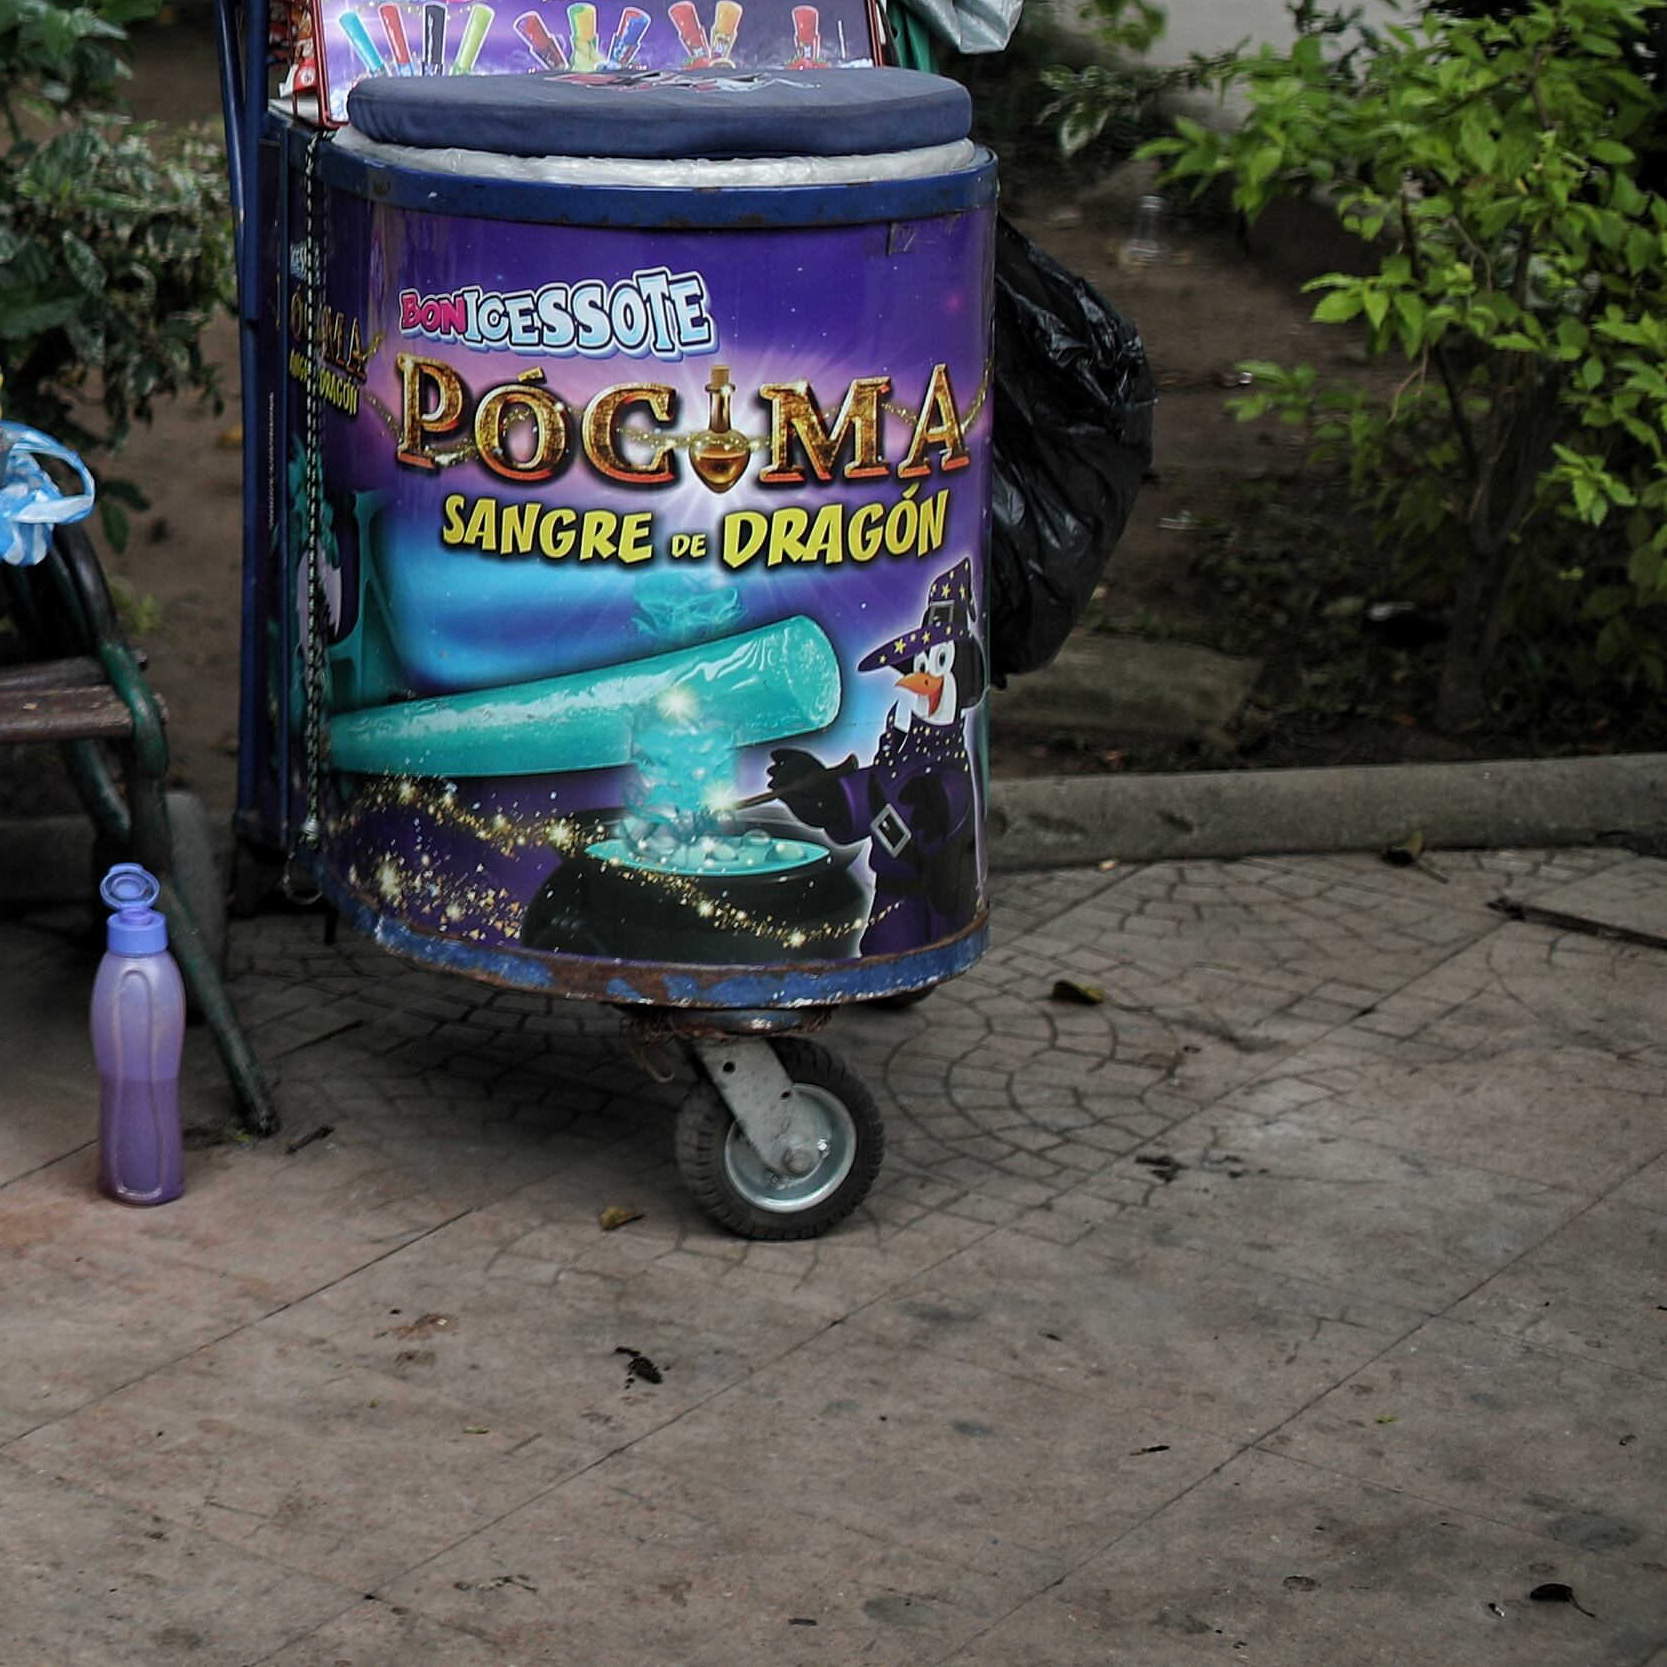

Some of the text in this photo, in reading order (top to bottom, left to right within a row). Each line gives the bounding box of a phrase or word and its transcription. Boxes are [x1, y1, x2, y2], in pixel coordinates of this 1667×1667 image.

[398, 266, 719, 359] BONICESSOTE
[441, 484, 951, 570] SANGRE DE DRAGÓN
